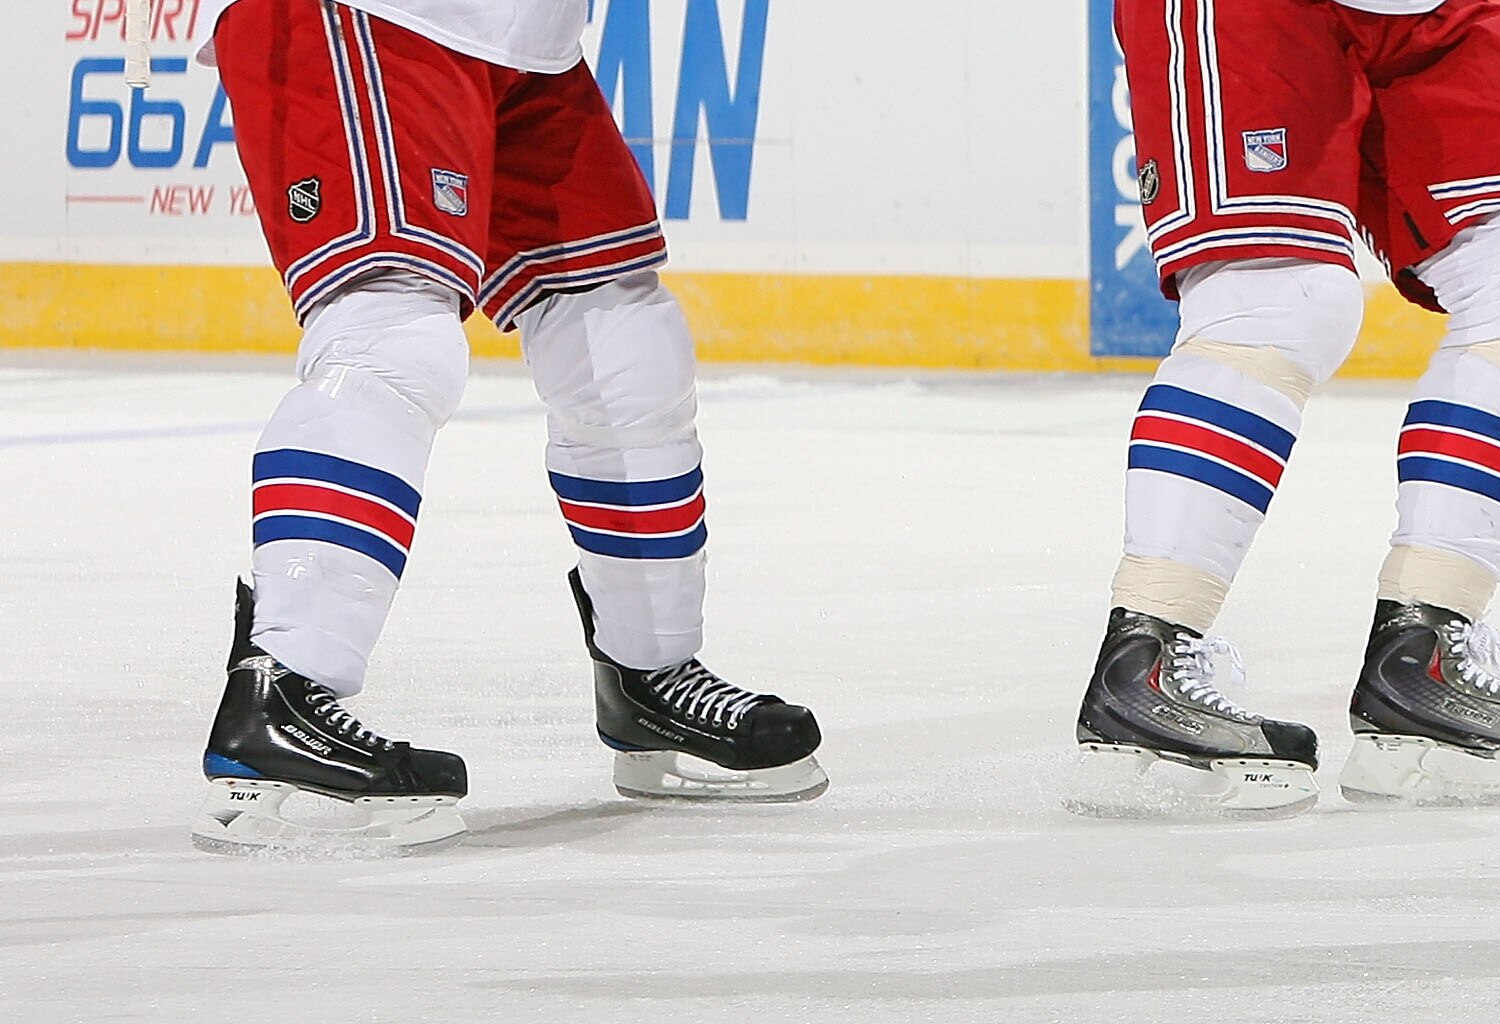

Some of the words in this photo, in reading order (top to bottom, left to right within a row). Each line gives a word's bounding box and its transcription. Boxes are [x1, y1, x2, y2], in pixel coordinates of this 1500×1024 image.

[151, 185, 214, 217] NEW
[293, 188, 315, 212] NHL
[638, 718, 686, 743] BAUER
